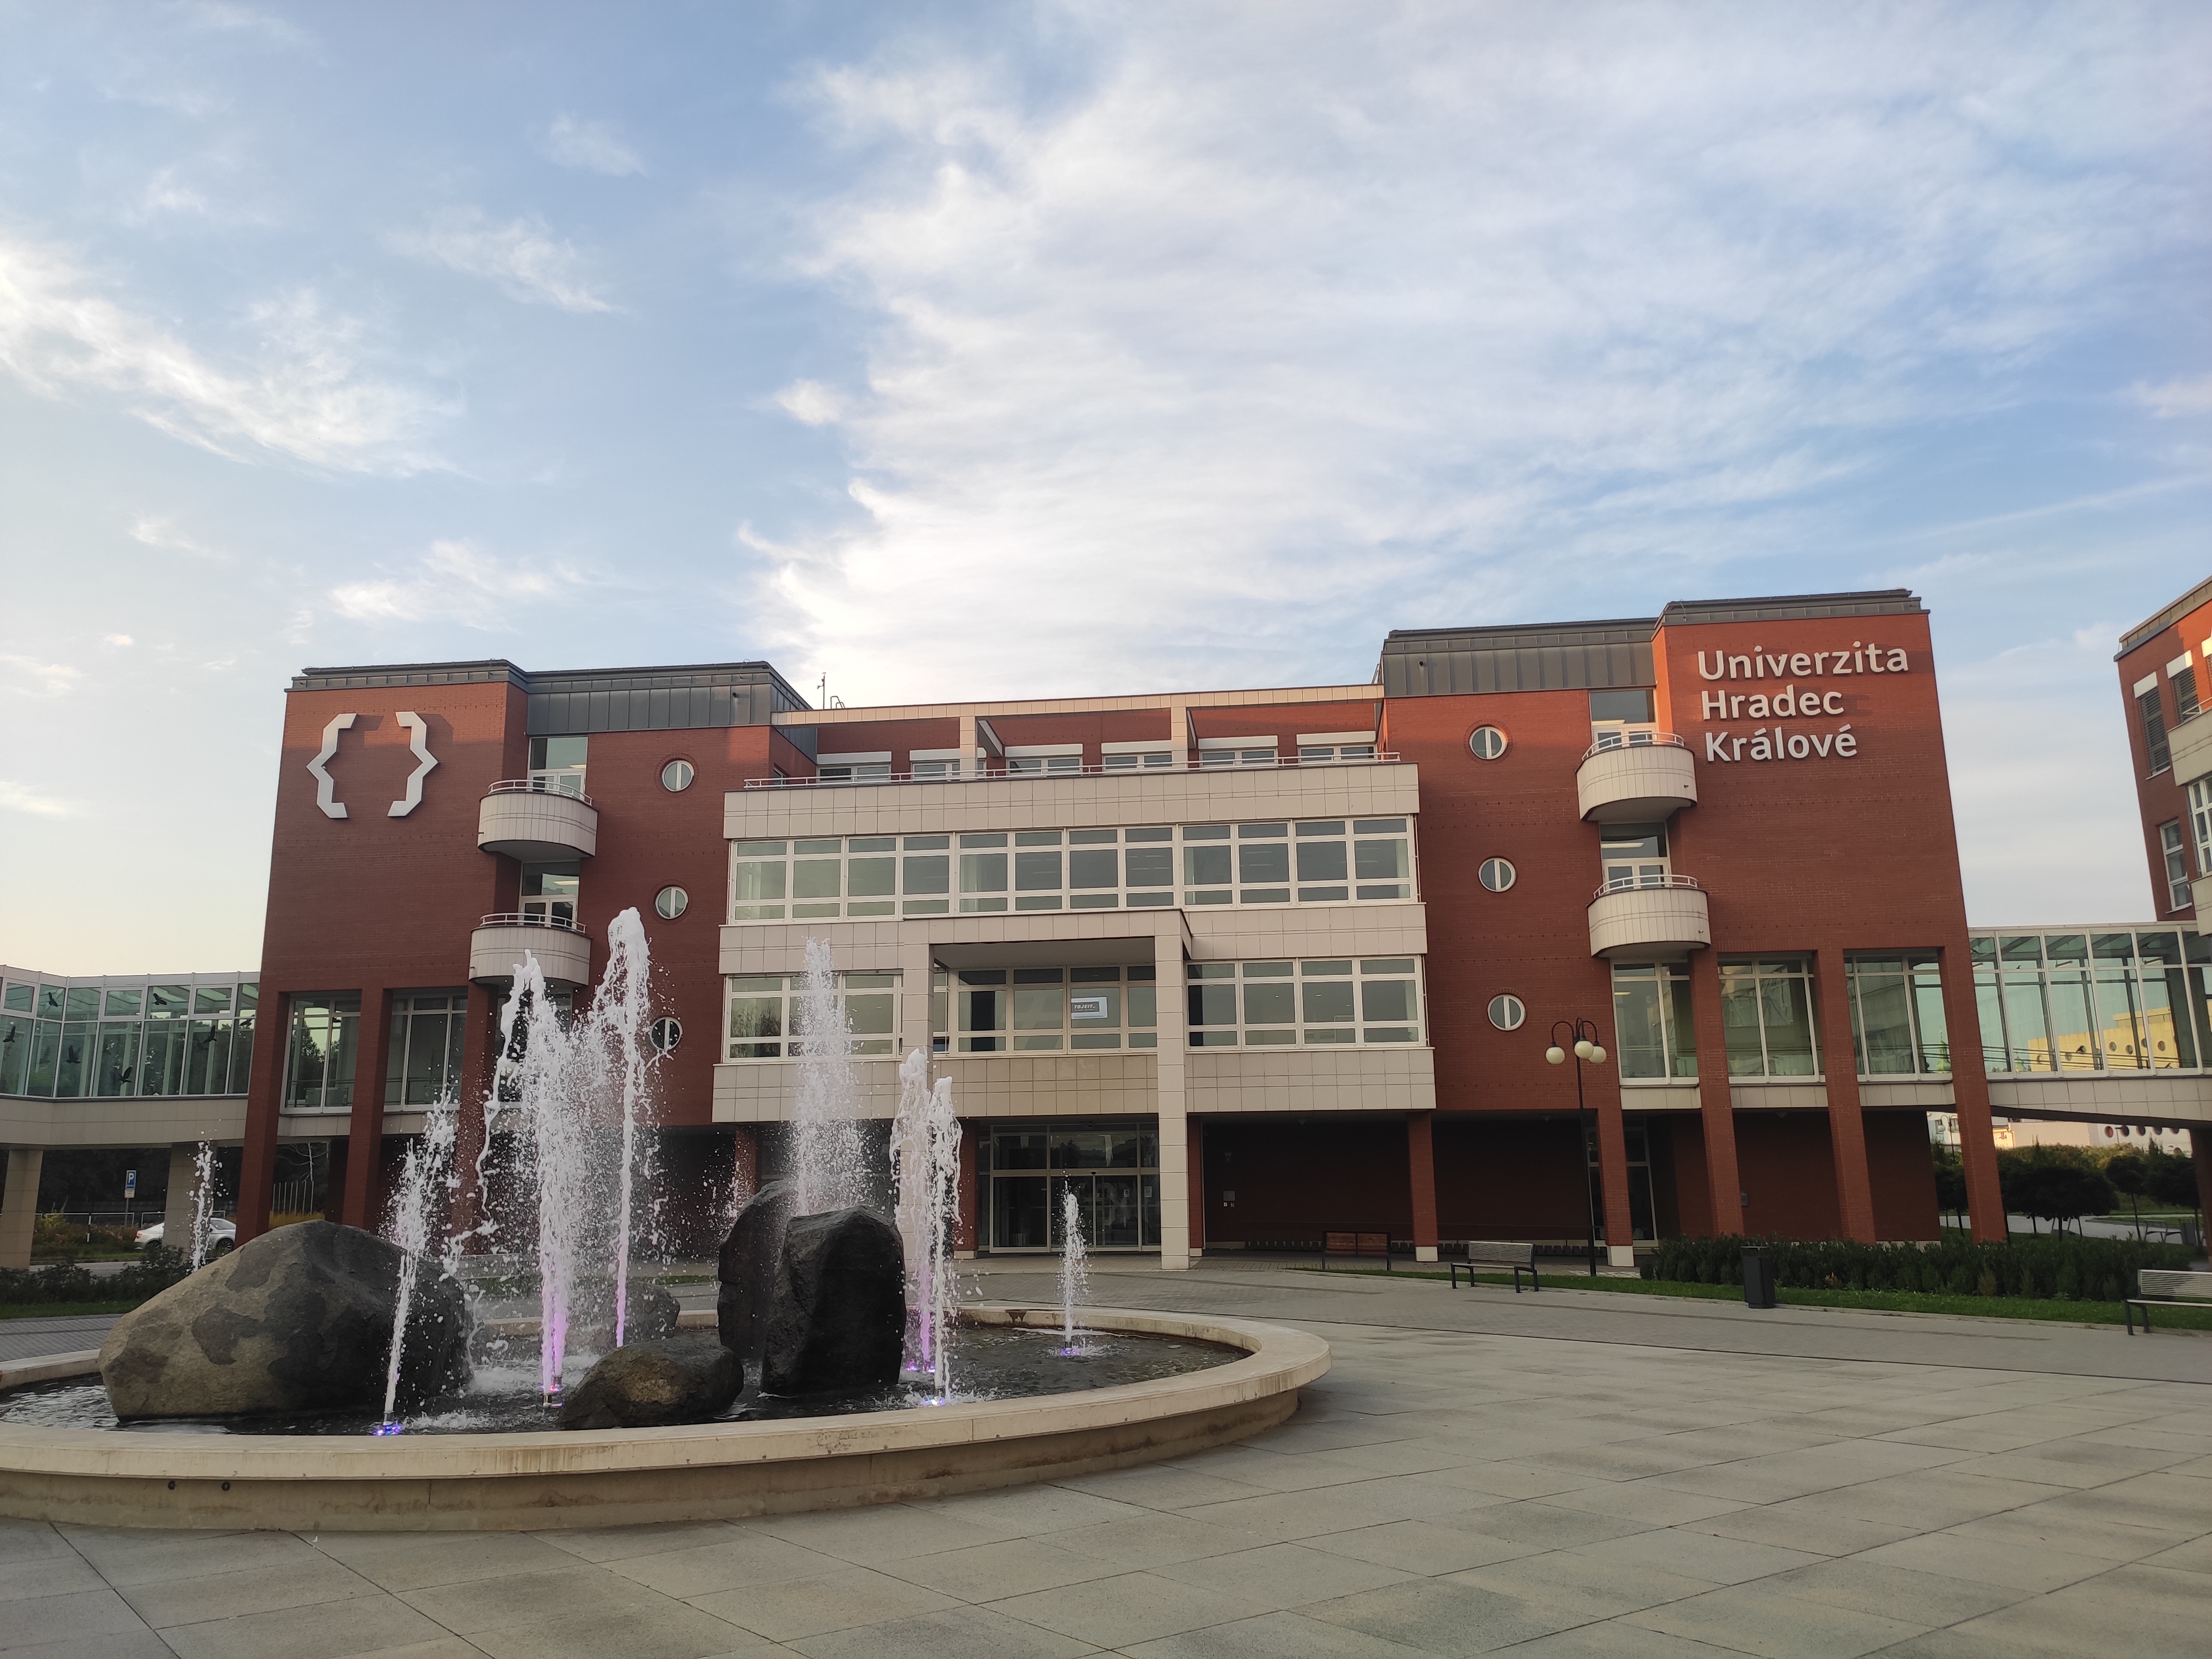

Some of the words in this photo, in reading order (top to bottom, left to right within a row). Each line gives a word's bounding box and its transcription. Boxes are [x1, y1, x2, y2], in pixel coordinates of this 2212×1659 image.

[1698, 640, 1908, 680] Univerzita
[1701, 684, 1844, 720] Hradec
[1705, 723, 1858, 762] Králové
[128, 1172, 134, 1184] P
